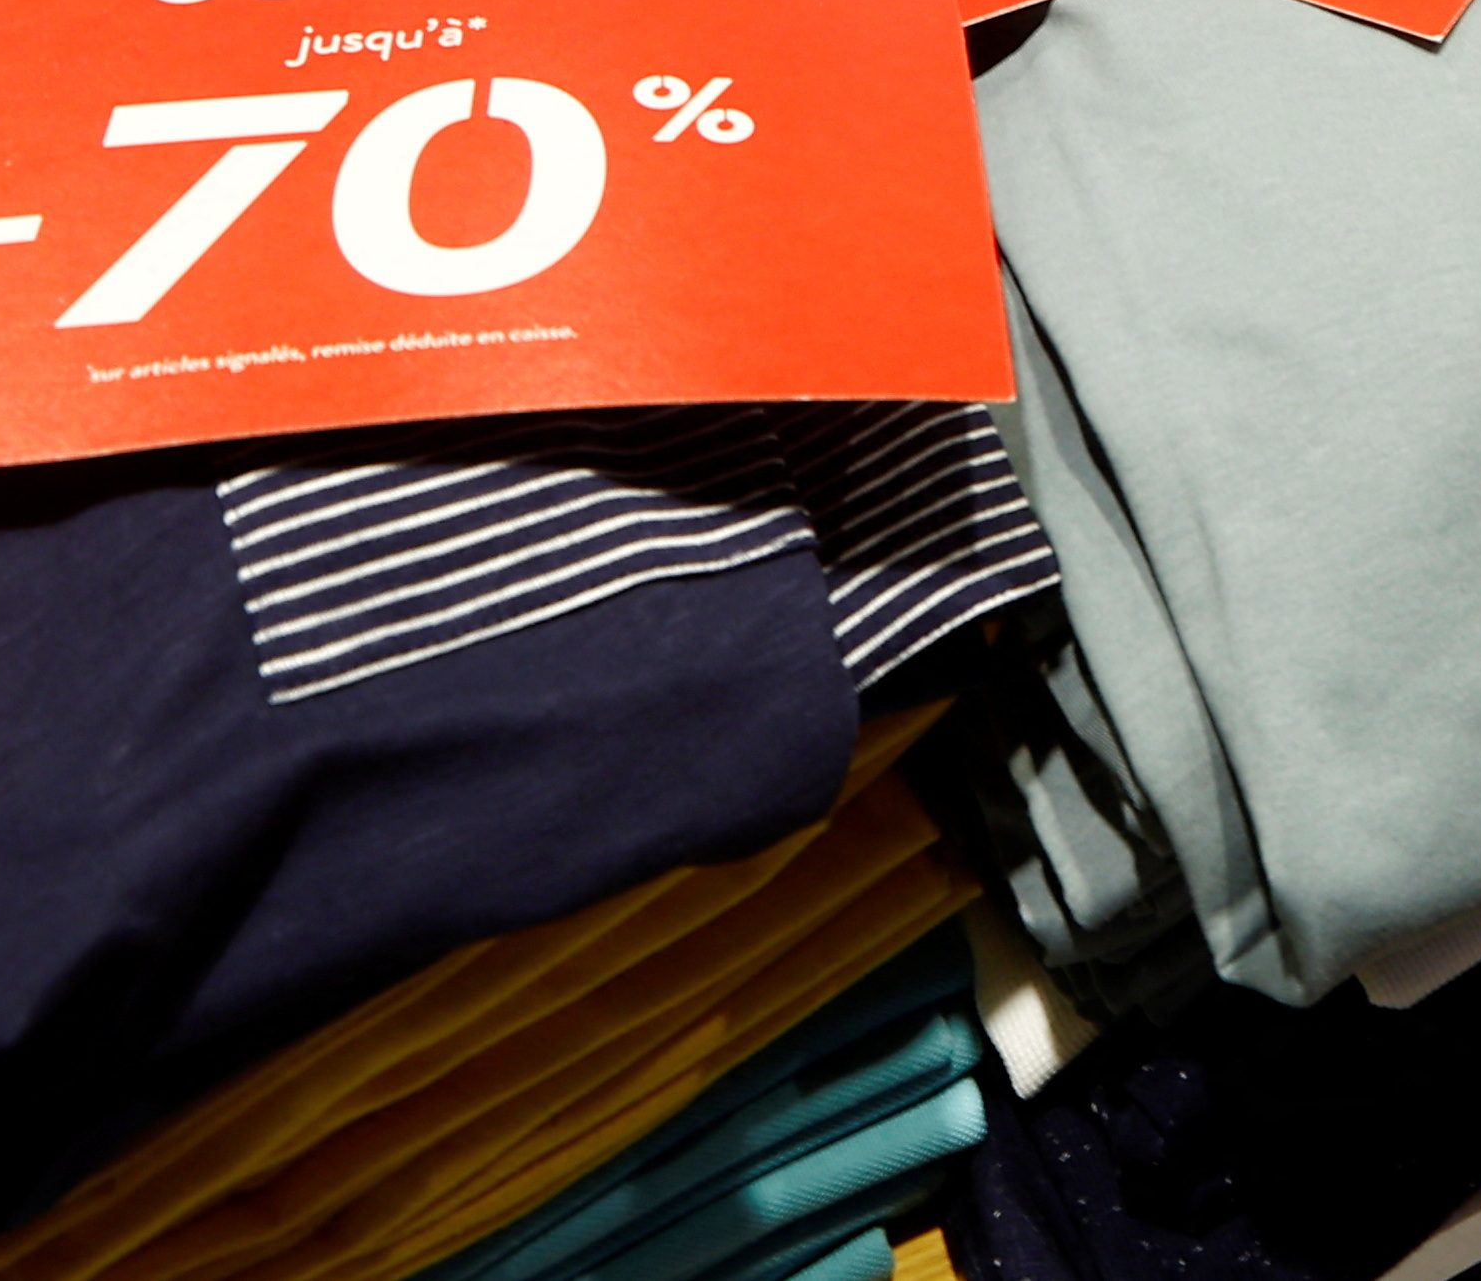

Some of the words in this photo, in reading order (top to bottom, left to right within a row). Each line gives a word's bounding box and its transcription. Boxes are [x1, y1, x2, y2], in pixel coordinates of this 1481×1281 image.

[129, 356, 210, 380] articles
[215, 345, 307, 373] signalés,
[311, 336, 386, 359] remise
[389, 330, 473, 353] déduite
[476, 329, 506, 345] en
[509, 323, 579, 342] caisse.
